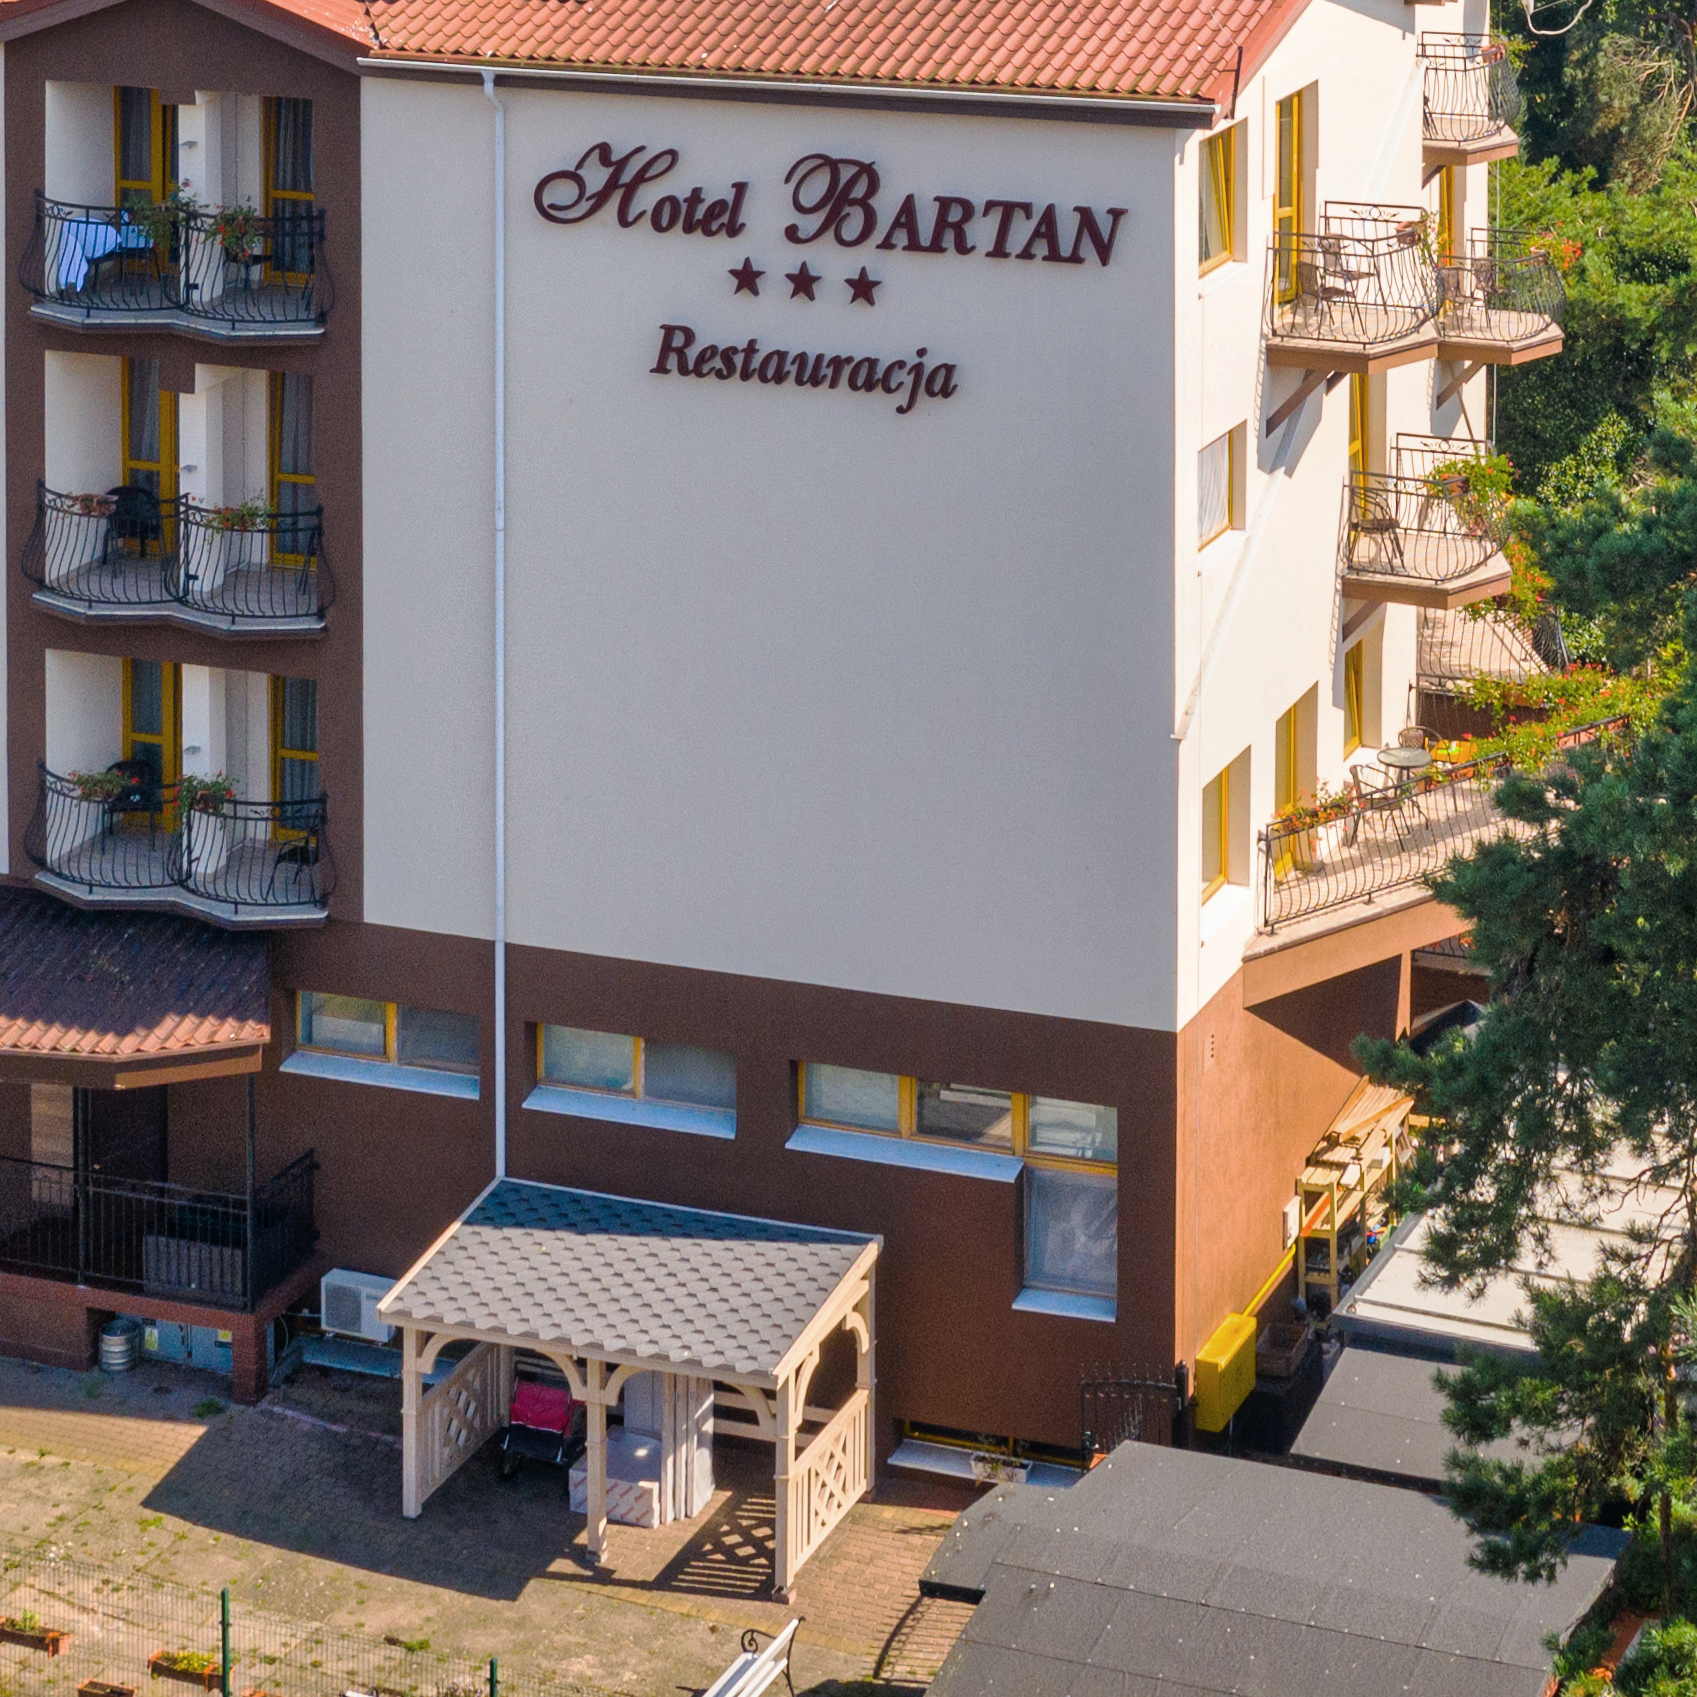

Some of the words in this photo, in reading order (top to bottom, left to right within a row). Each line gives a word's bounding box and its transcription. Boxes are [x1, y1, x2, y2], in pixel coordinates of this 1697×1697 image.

[533, 141, 748, 239] Hotel
[783, 152, 1129, 268] BARTAN
[648, 323, 959, 415] Restauracja
